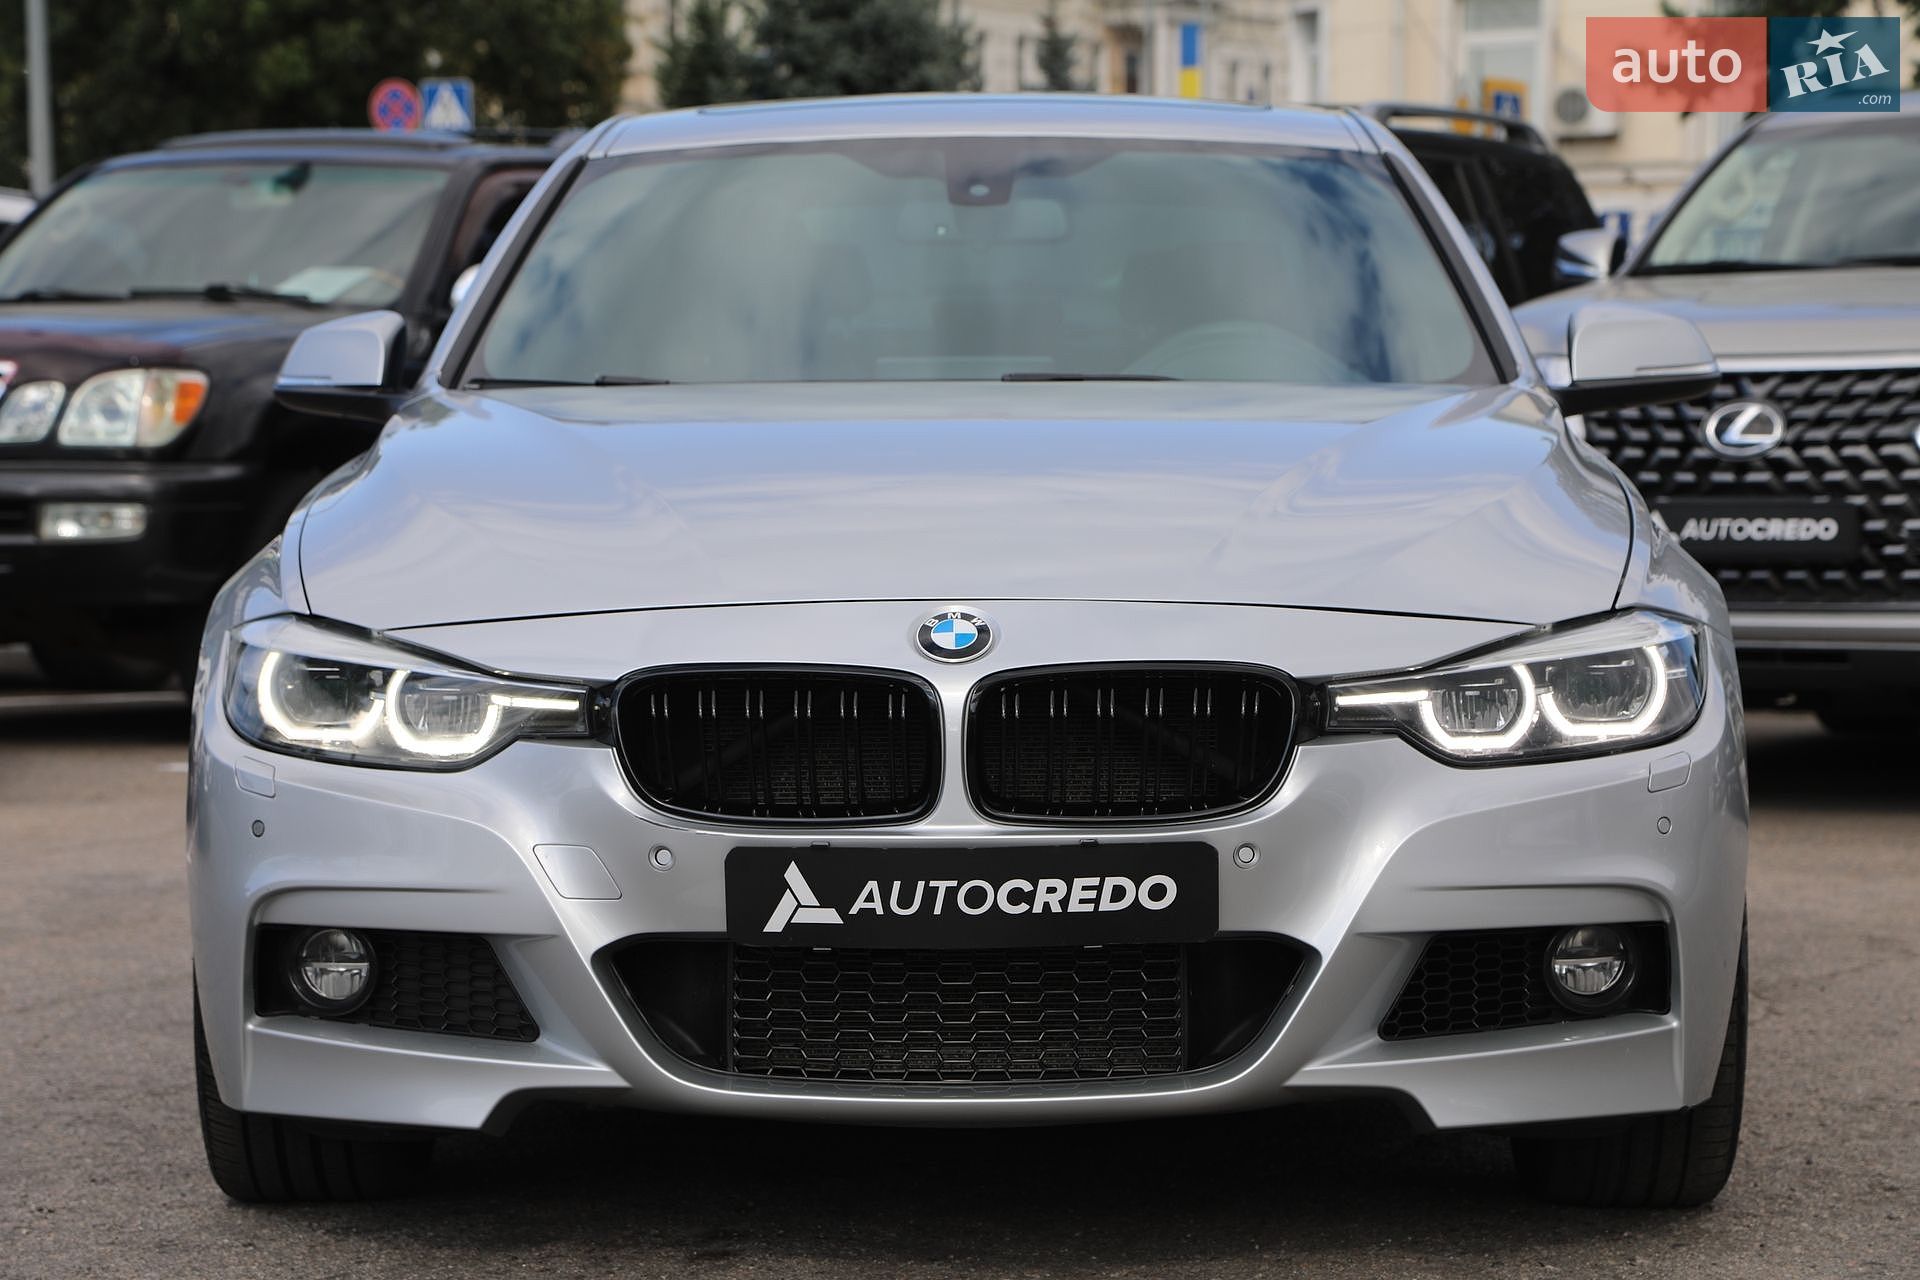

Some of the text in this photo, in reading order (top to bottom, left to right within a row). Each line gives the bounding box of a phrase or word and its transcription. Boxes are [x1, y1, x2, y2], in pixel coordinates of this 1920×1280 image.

[1679, 517, 1839, 542] AUTOCREDO
[923, 612, 986, 628] BMW
[848, 874, 1178, 916] AUTOCREDO
